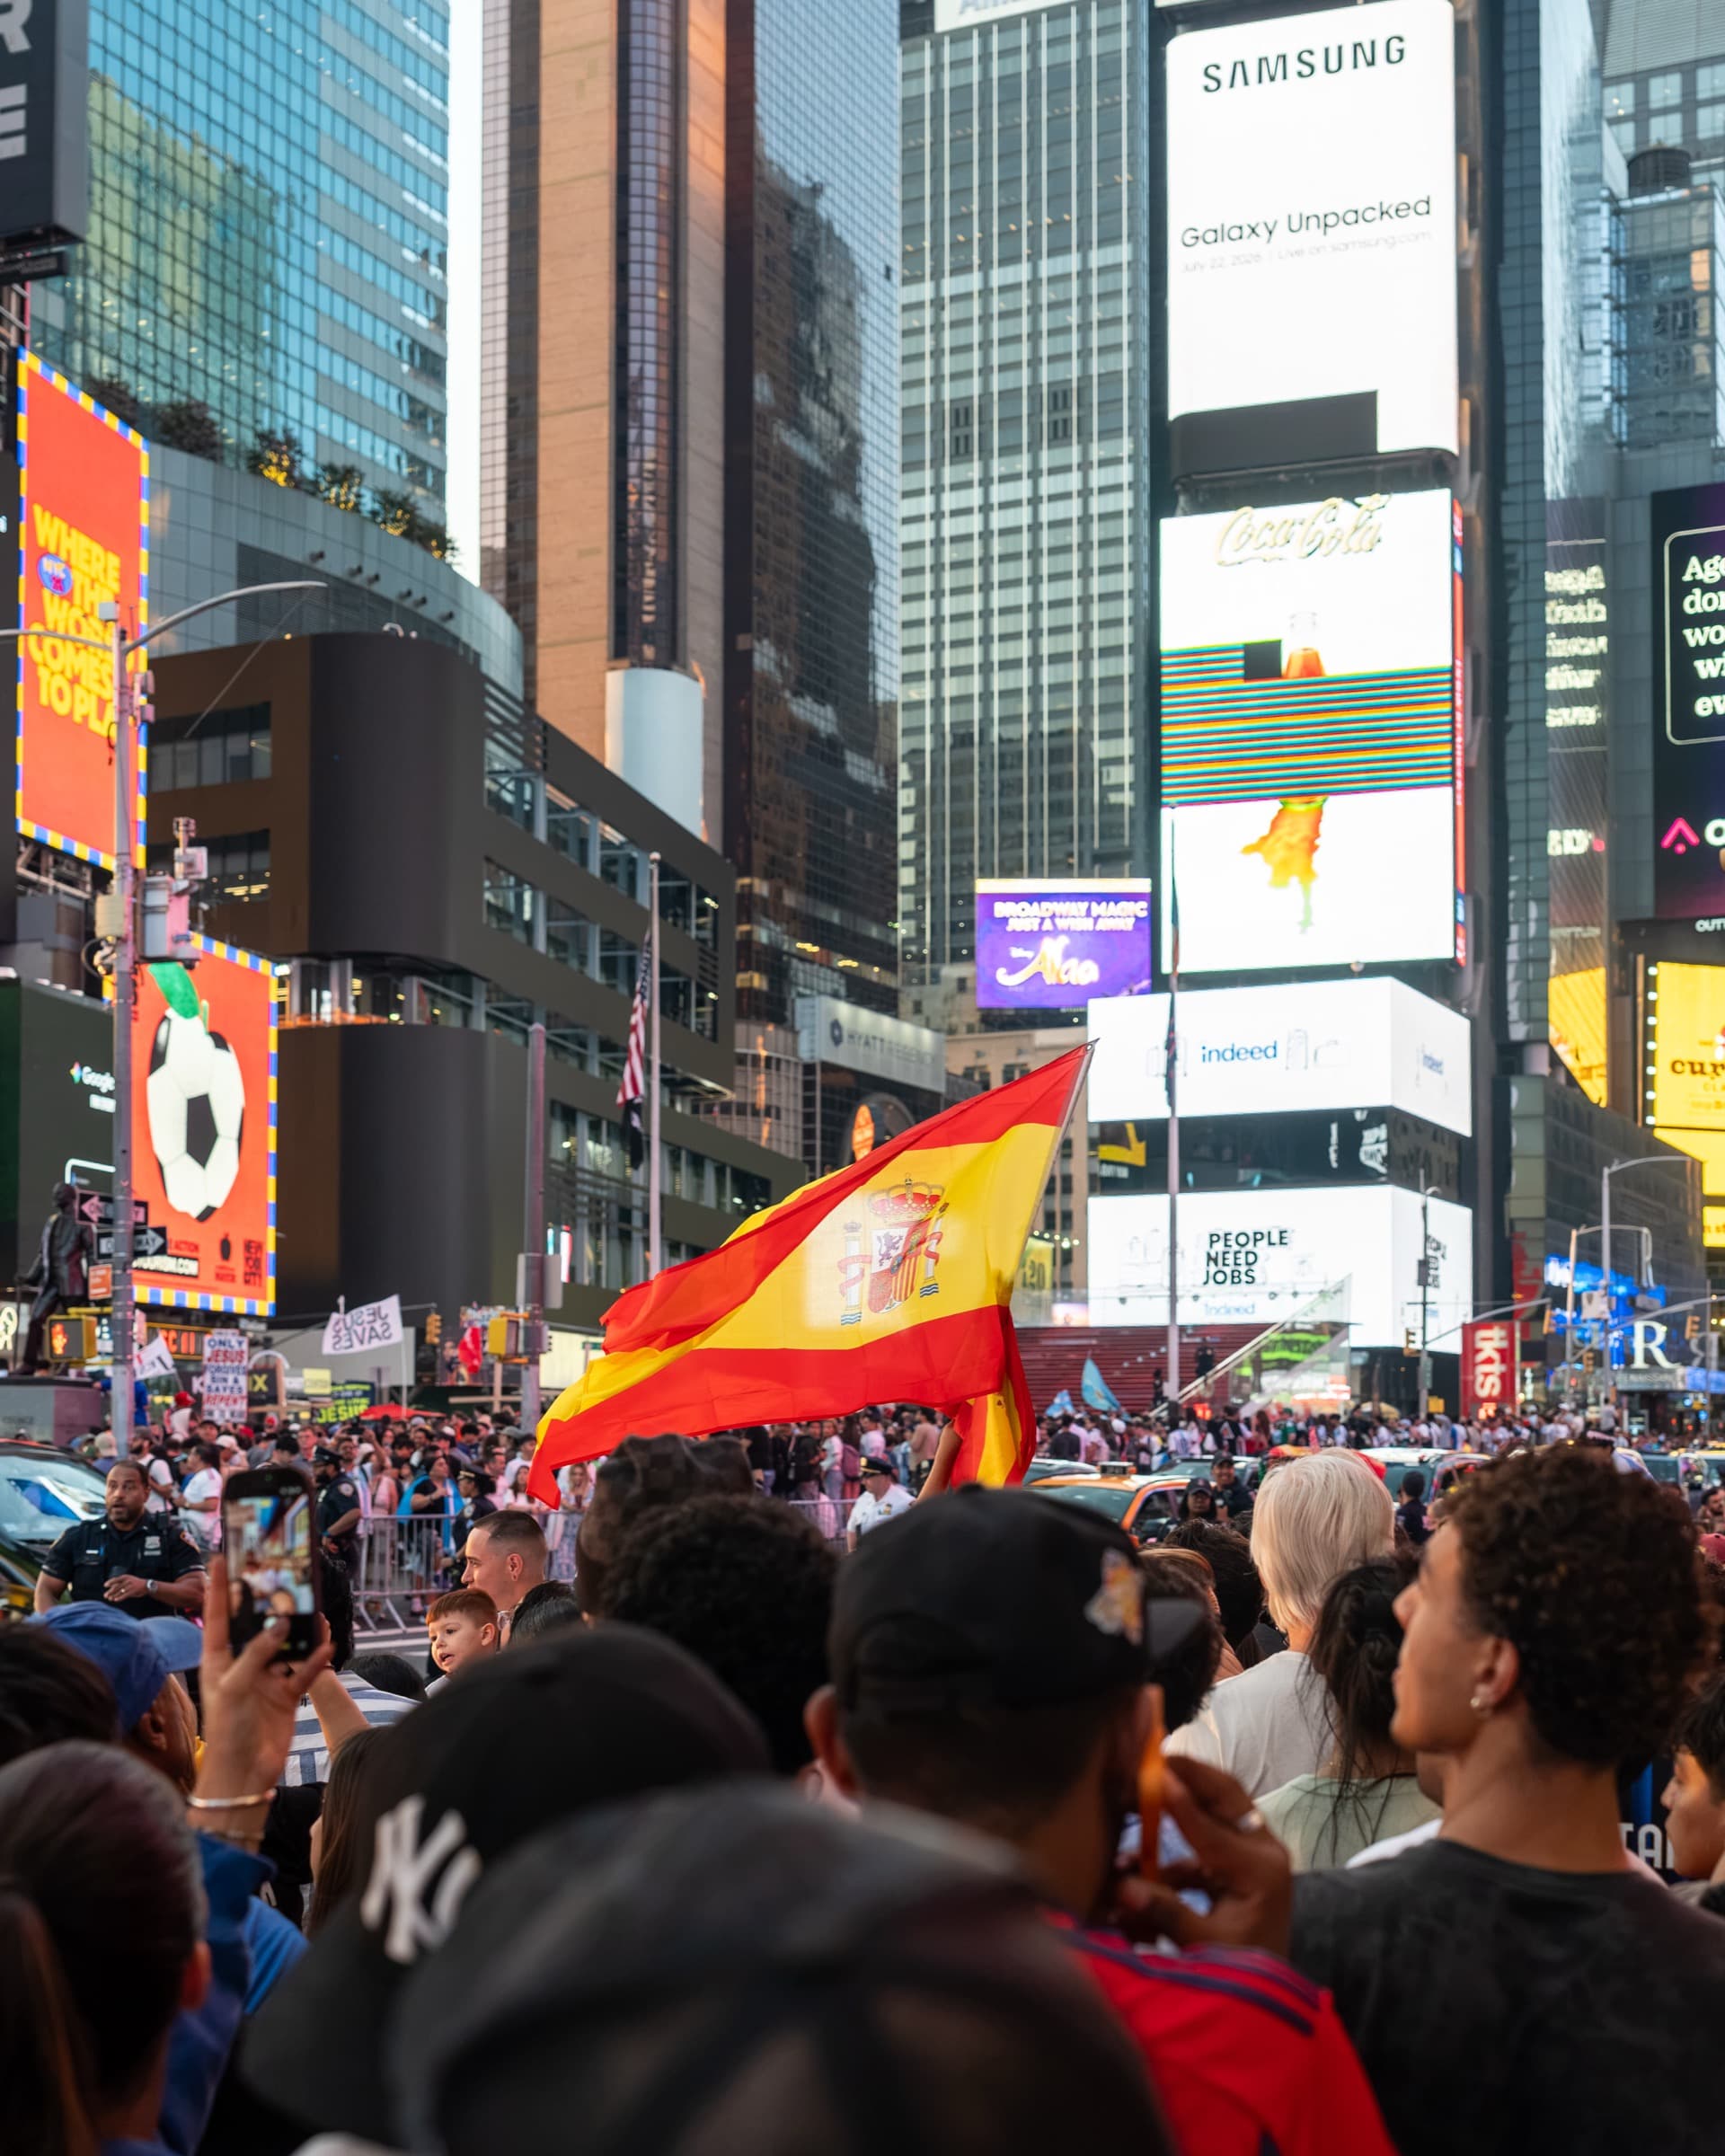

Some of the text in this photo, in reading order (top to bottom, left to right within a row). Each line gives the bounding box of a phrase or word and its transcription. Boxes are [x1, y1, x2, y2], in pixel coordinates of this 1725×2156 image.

[1202, 33, 1406, 93] SAMSUNG
[1181, 195, 1432, 248] Galaxy Unpacked
[1278, 246, 1305, 261] Live
[1308, 243, 1328, 255] on
[32, 503, 121, 595] WHERE
[27, 622, 115, 702] COMES
[38, 664, 135, 740] TO PLA
[994, 900, 1149, 918] BROADWAY MAGIC
[1005, 917, 1040, 932] JUST
[1041, 917, 1053, 932] A
[1094, 917, 1137, 932] AWAY
[847, 1033, 885, 1054] HYATT
[1201, 1040, 1278, 1065] indeed
[1208, 1229, 1289, 1249] PEOPLE
[1206, 1250, 1259, 1268] NEED
[1202, 1268, 1257, 1286] JOBS
[208, 1338, 245, 1348] ONLY
[1630, 1321, 1681, 1369] R
[208, 1349, 245, 1364] JESUS
[1474, 1326, 1508, 1399] tkts
